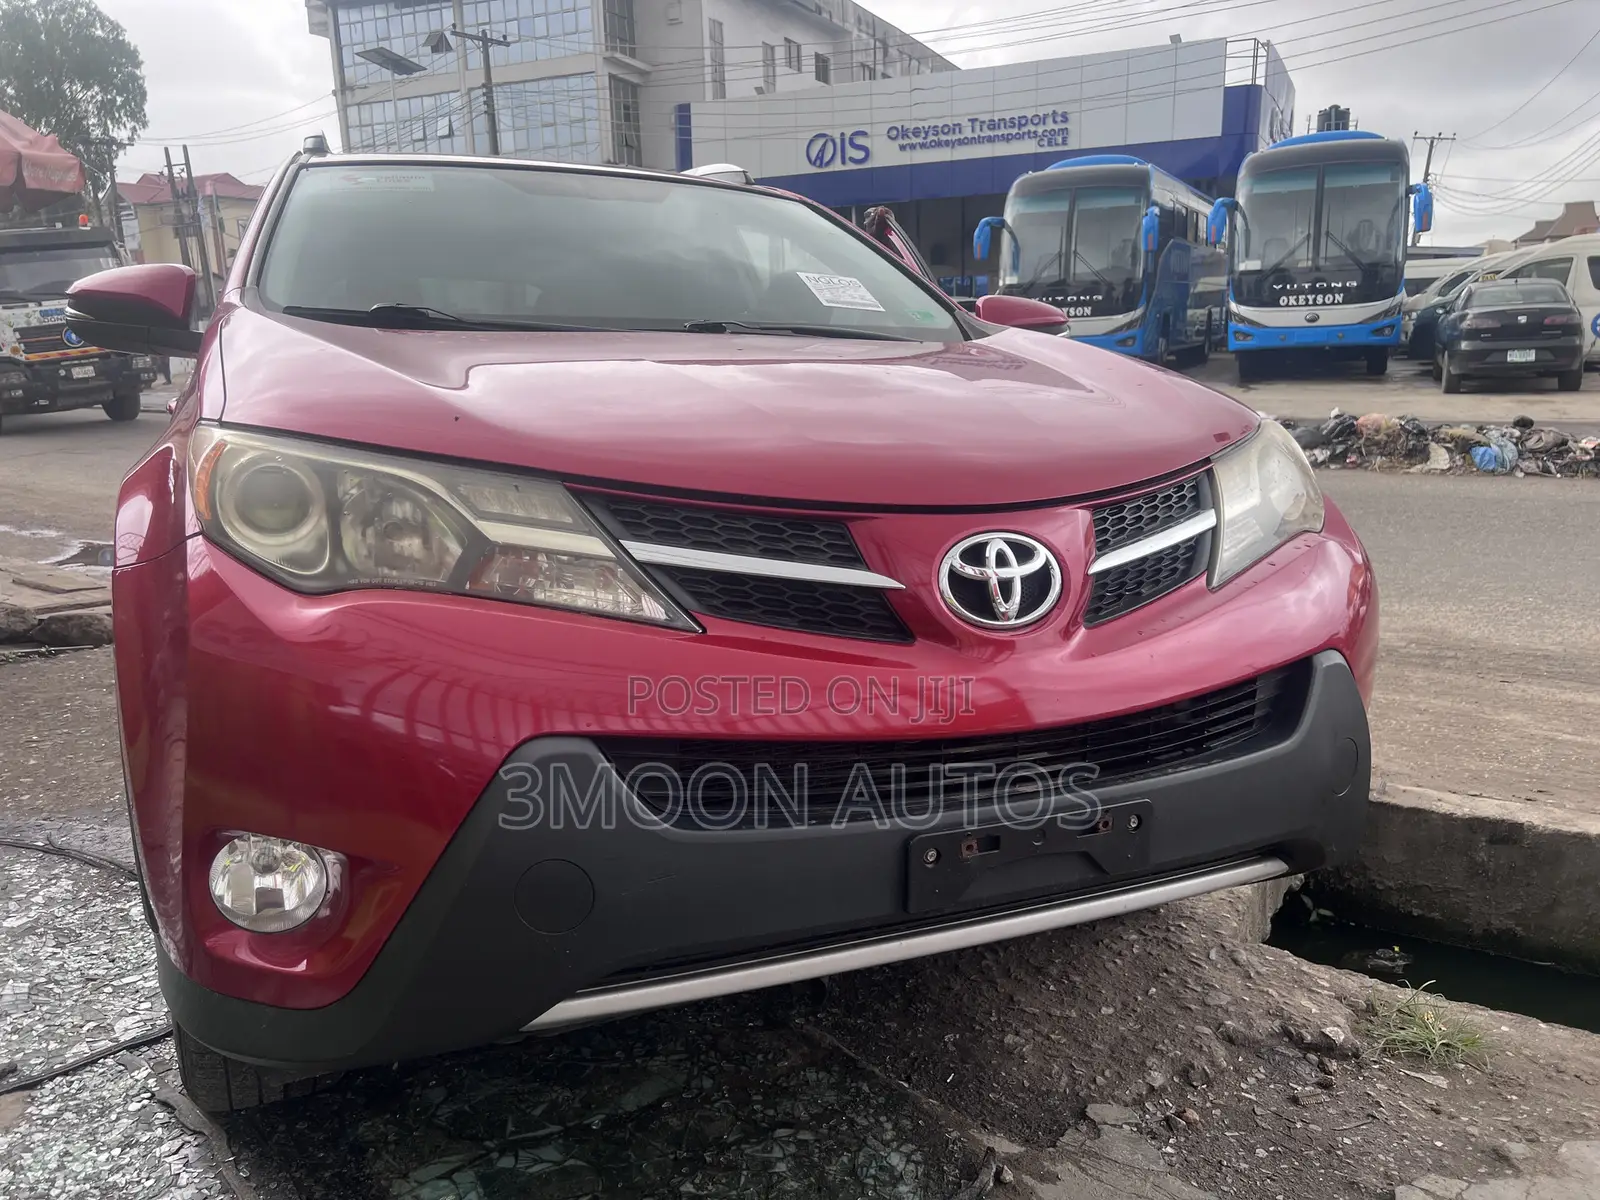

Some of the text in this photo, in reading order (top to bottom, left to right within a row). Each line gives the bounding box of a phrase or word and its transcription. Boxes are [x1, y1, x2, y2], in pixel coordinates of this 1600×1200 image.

[886, 110, 1070, 142] Okeyson Transports
[898, 126, 1069, 151] www.okeysontransports.com
[1272, 280, 1358, 290] YUTONG
[1279, 293, 1344, 306] OKEYSON
[1061, 306, 1092, 316] YSON
